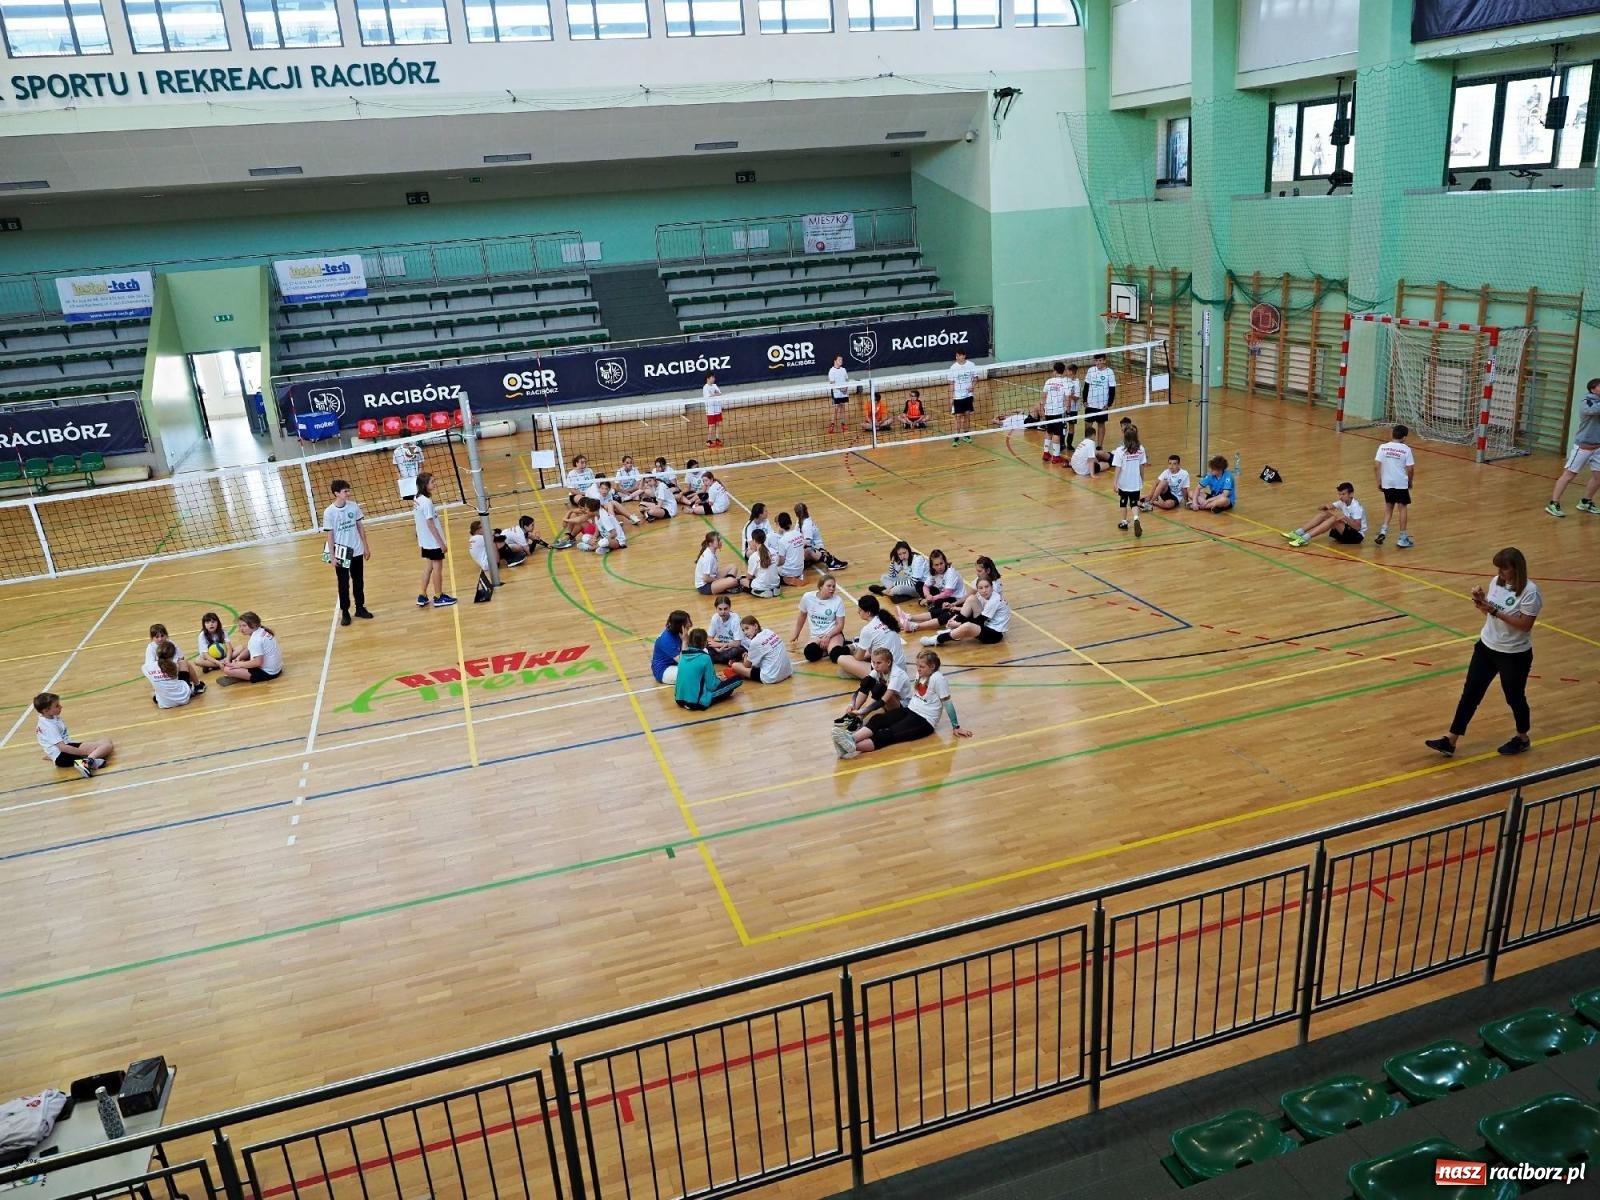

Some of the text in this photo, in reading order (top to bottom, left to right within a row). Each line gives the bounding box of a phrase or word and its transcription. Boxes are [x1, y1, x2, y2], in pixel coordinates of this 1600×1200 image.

[11, 57, 440, 100] SPORTU I REKREACJI RACIBÓRZ
[809, 214, 848, 225] MIESZKO
[892, 329, 969, 351] RACIBÓRZ
[767, 342, 815, 363] OSiR
[786, 359, 816, 368] RACIBÓRZ
[644, 354, 731, 378] RACIBÓRZ
[502, 369, 558, 392] OSiR
[363, 383, 461, 409] RACIBÓRZ
[0, 421, 111, 449] RACIBÓRZ
[395, 645, 590, 688] RAFAKO
